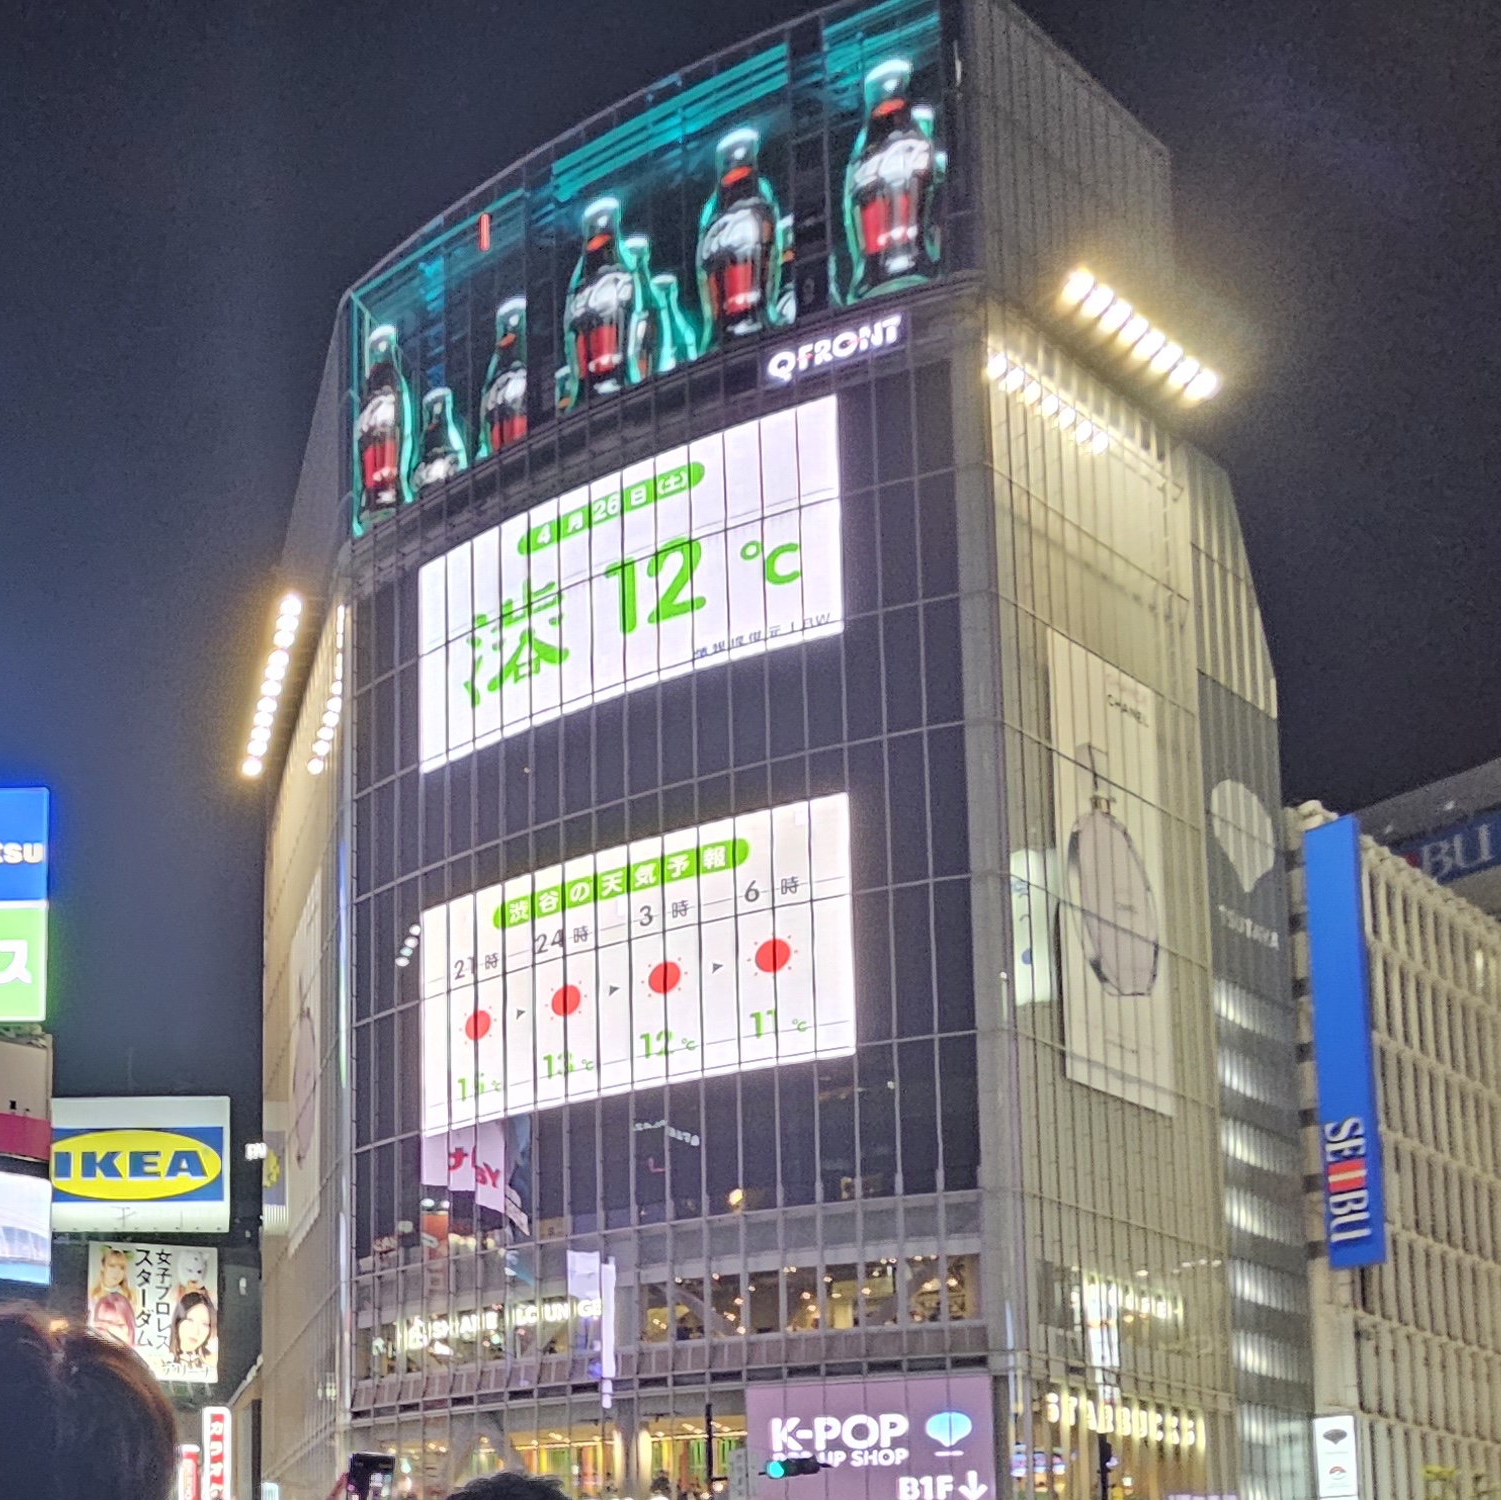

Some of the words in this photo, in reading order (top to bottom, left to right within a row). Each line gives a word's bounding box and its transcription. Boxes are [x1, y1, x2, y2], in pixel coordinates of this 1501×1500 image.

[766, 315, 902, 383] QFRONT
[508, 845, 726, 924] 渋谷の天気予報
[54, 1150, 209, 1180] IKEA
[1324, 1116, 1373, 1243] SEIBU
[134, 1248, 154, 1348] スターダム
[155, 1249, 173, 1351] 女子プロレス
[770, 1413, 910, 1453] K-POP
[850, 1448, 910, 1467] SHOP
